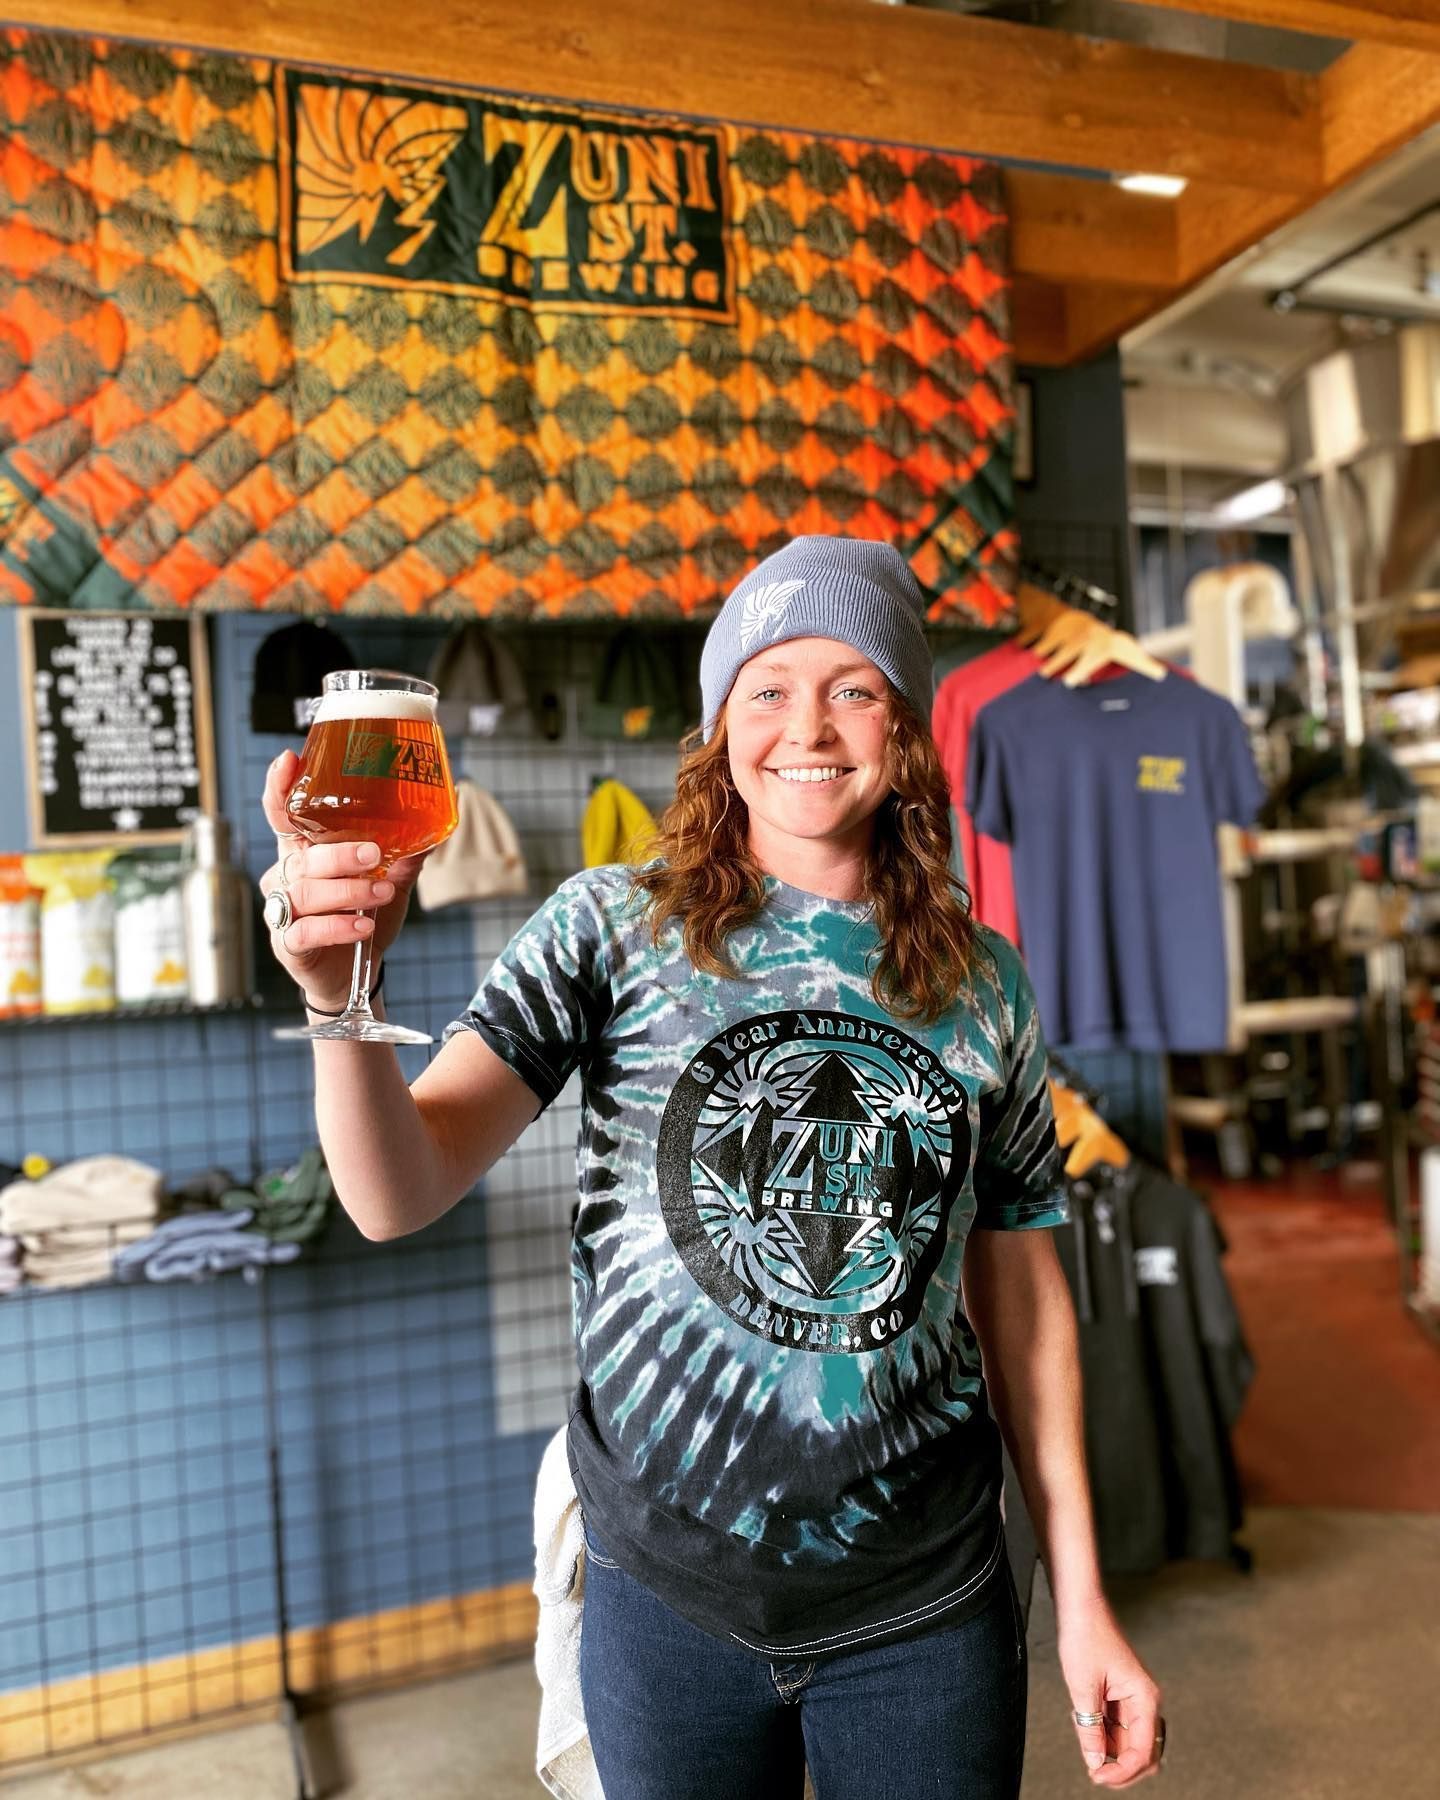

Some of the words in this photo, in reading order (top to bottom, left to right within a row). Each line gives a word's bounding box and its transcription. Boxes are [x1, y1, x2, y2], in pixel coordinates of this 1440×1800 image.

[479, 112, 716, 258] ZUNI
[588, 203, 698, 266] ST.
[691, 1060, 716, 1084] 6
[711, 1019, 780, 1060] Year
[793, 1013, 963, 1114] Anniversary
[763, 1119, 897, 1192] ZUNI
[825, 1163, 881, 1199] ST.
[761, 1190, 893, 1218] BREWING
[729, 1292, 862, 1348] DENVER,
[870, 1309, 904, 1341] CO
